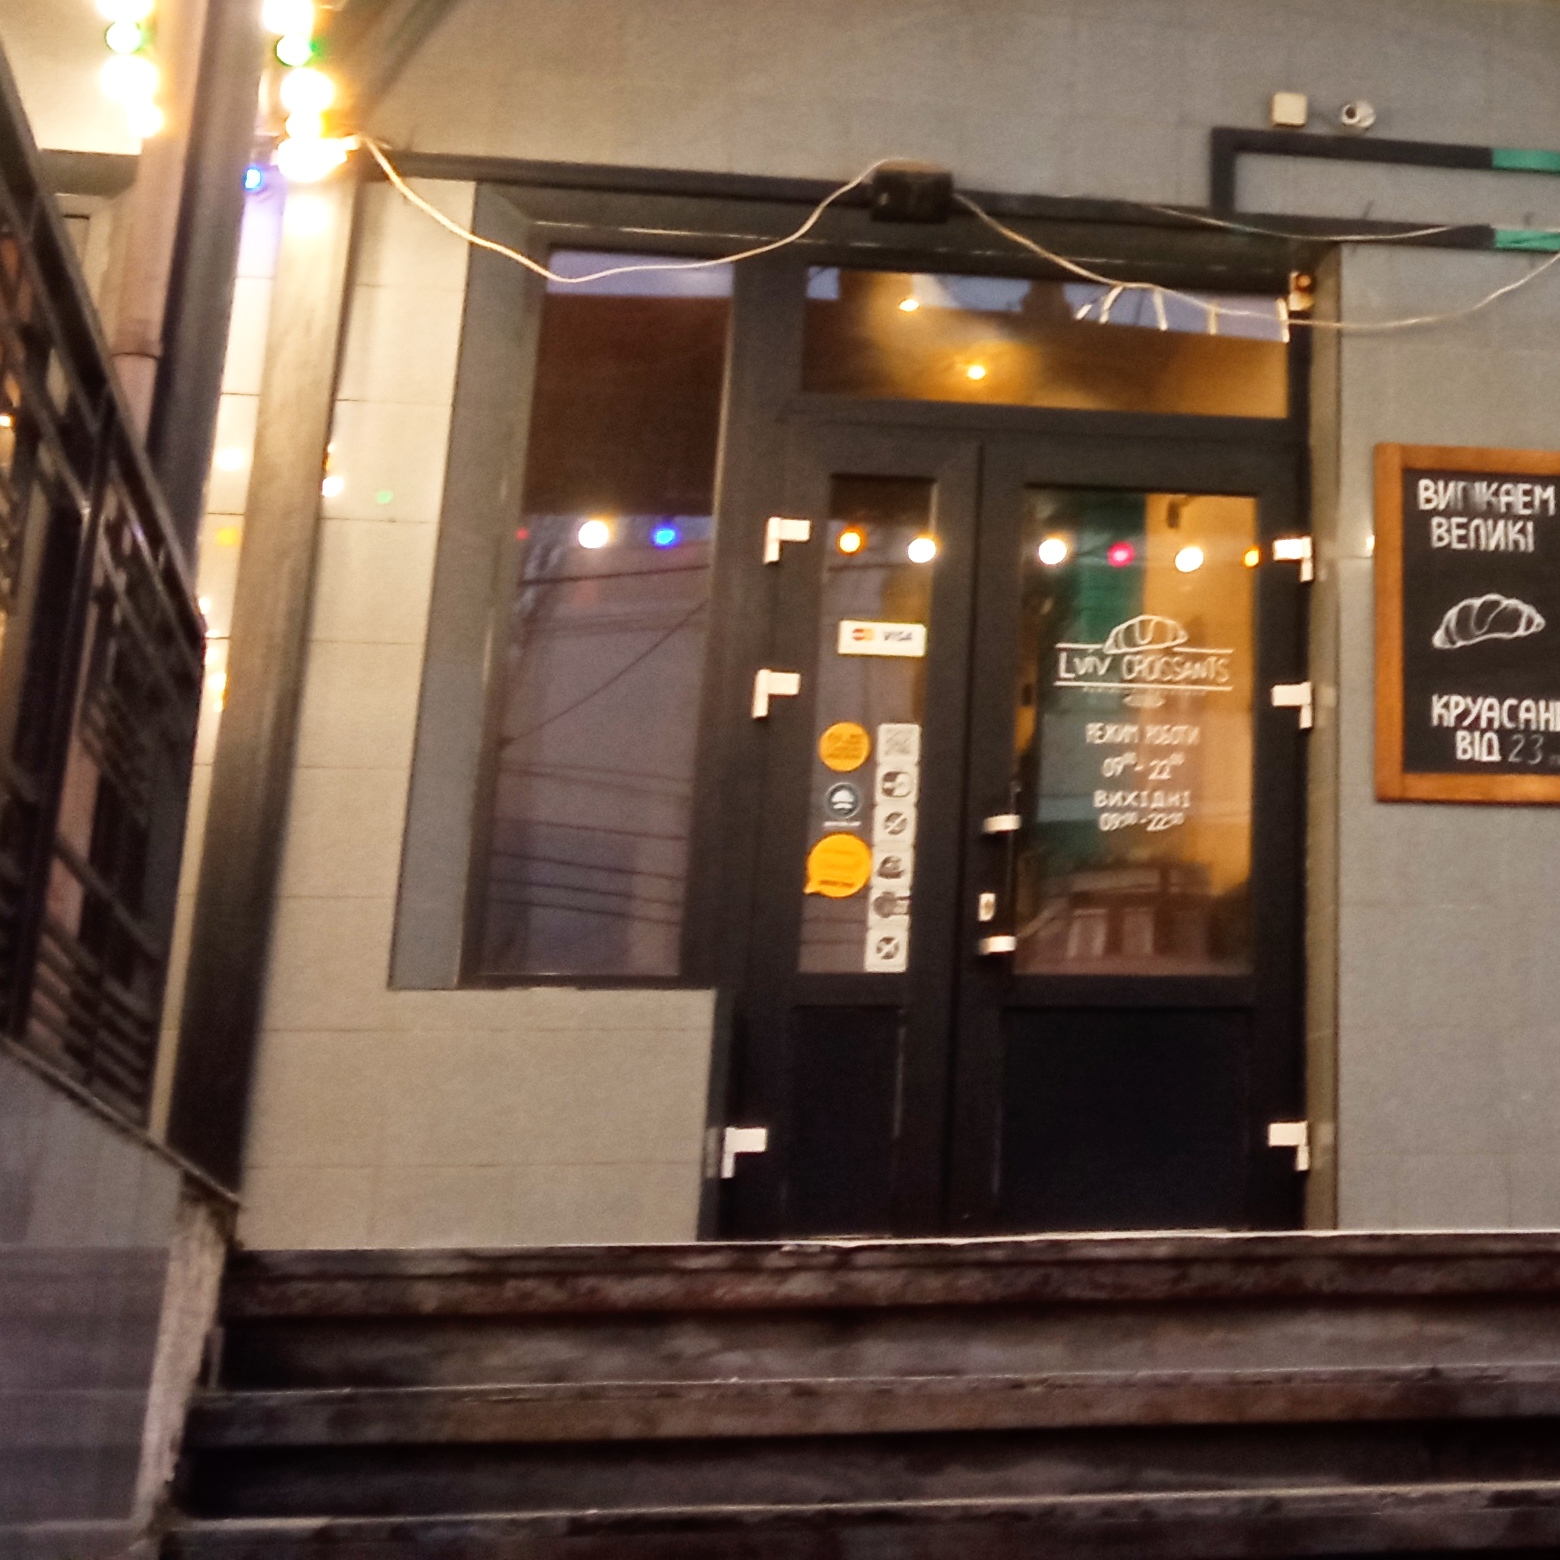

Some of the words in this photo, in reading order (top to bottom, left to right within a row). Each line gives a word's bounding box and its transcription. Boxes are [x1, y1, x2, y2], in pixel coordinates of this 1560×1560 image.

[1430, 516, 1535, 553] ВЕЛИКІ
[1455, 730, 1502, 763] ВІД
[1508, 733, 1545, 765] 23
